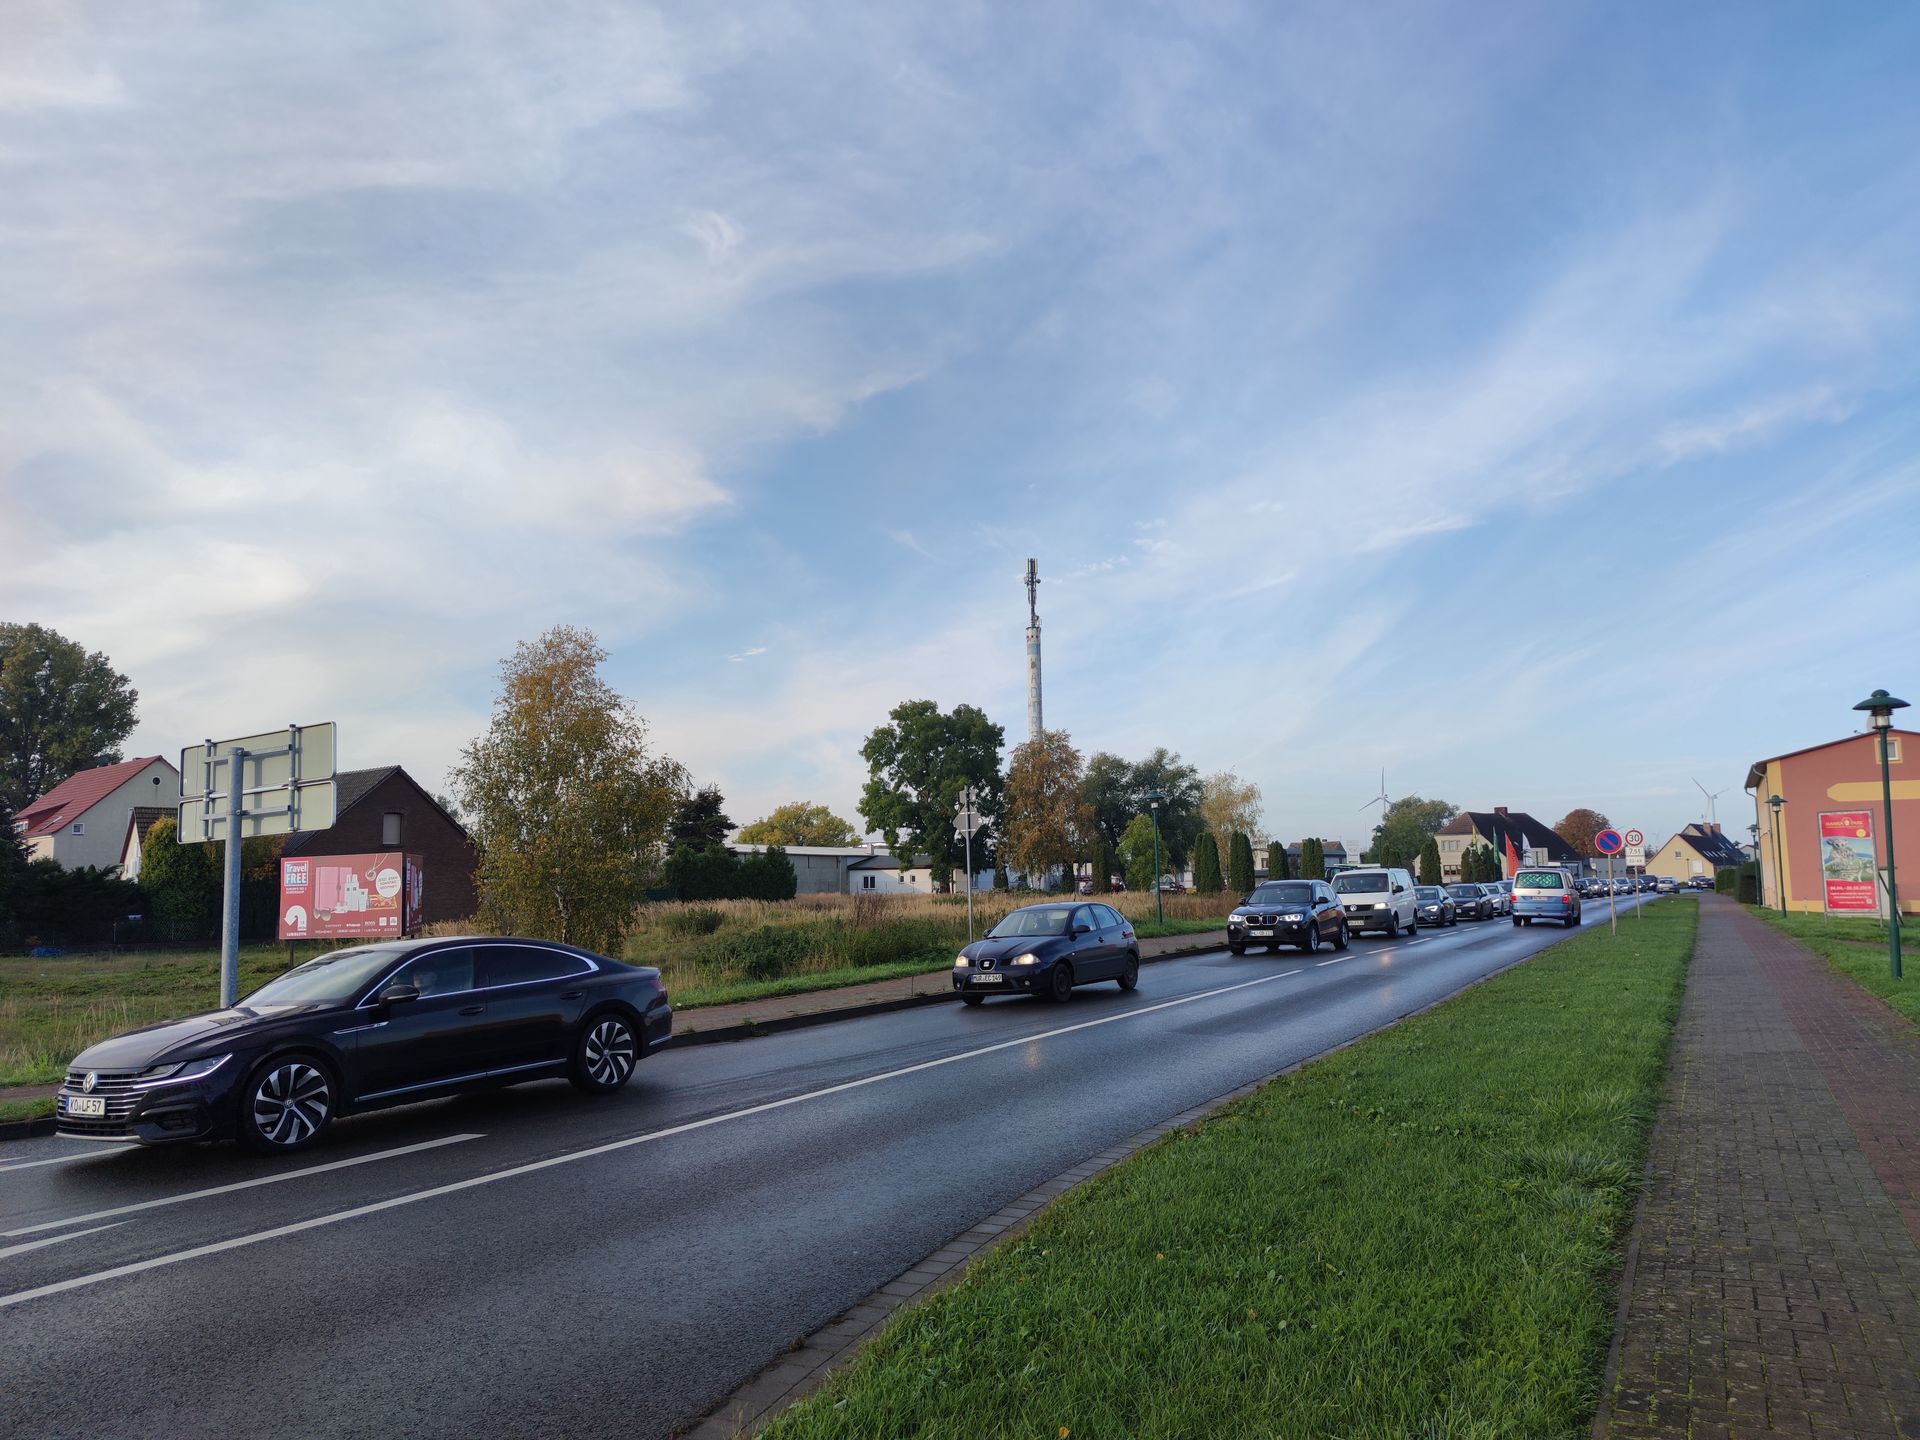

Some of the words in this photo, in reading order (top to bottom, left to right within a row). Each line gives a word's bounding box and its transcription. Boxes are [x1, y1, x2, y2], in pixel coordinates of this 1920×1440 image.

[1629, 834, 1640, 842] 30
[286, 863, 306, 872] Travel
[286, 873, 307, 884] FREE
[92, 1100, 102, 1113] 57
